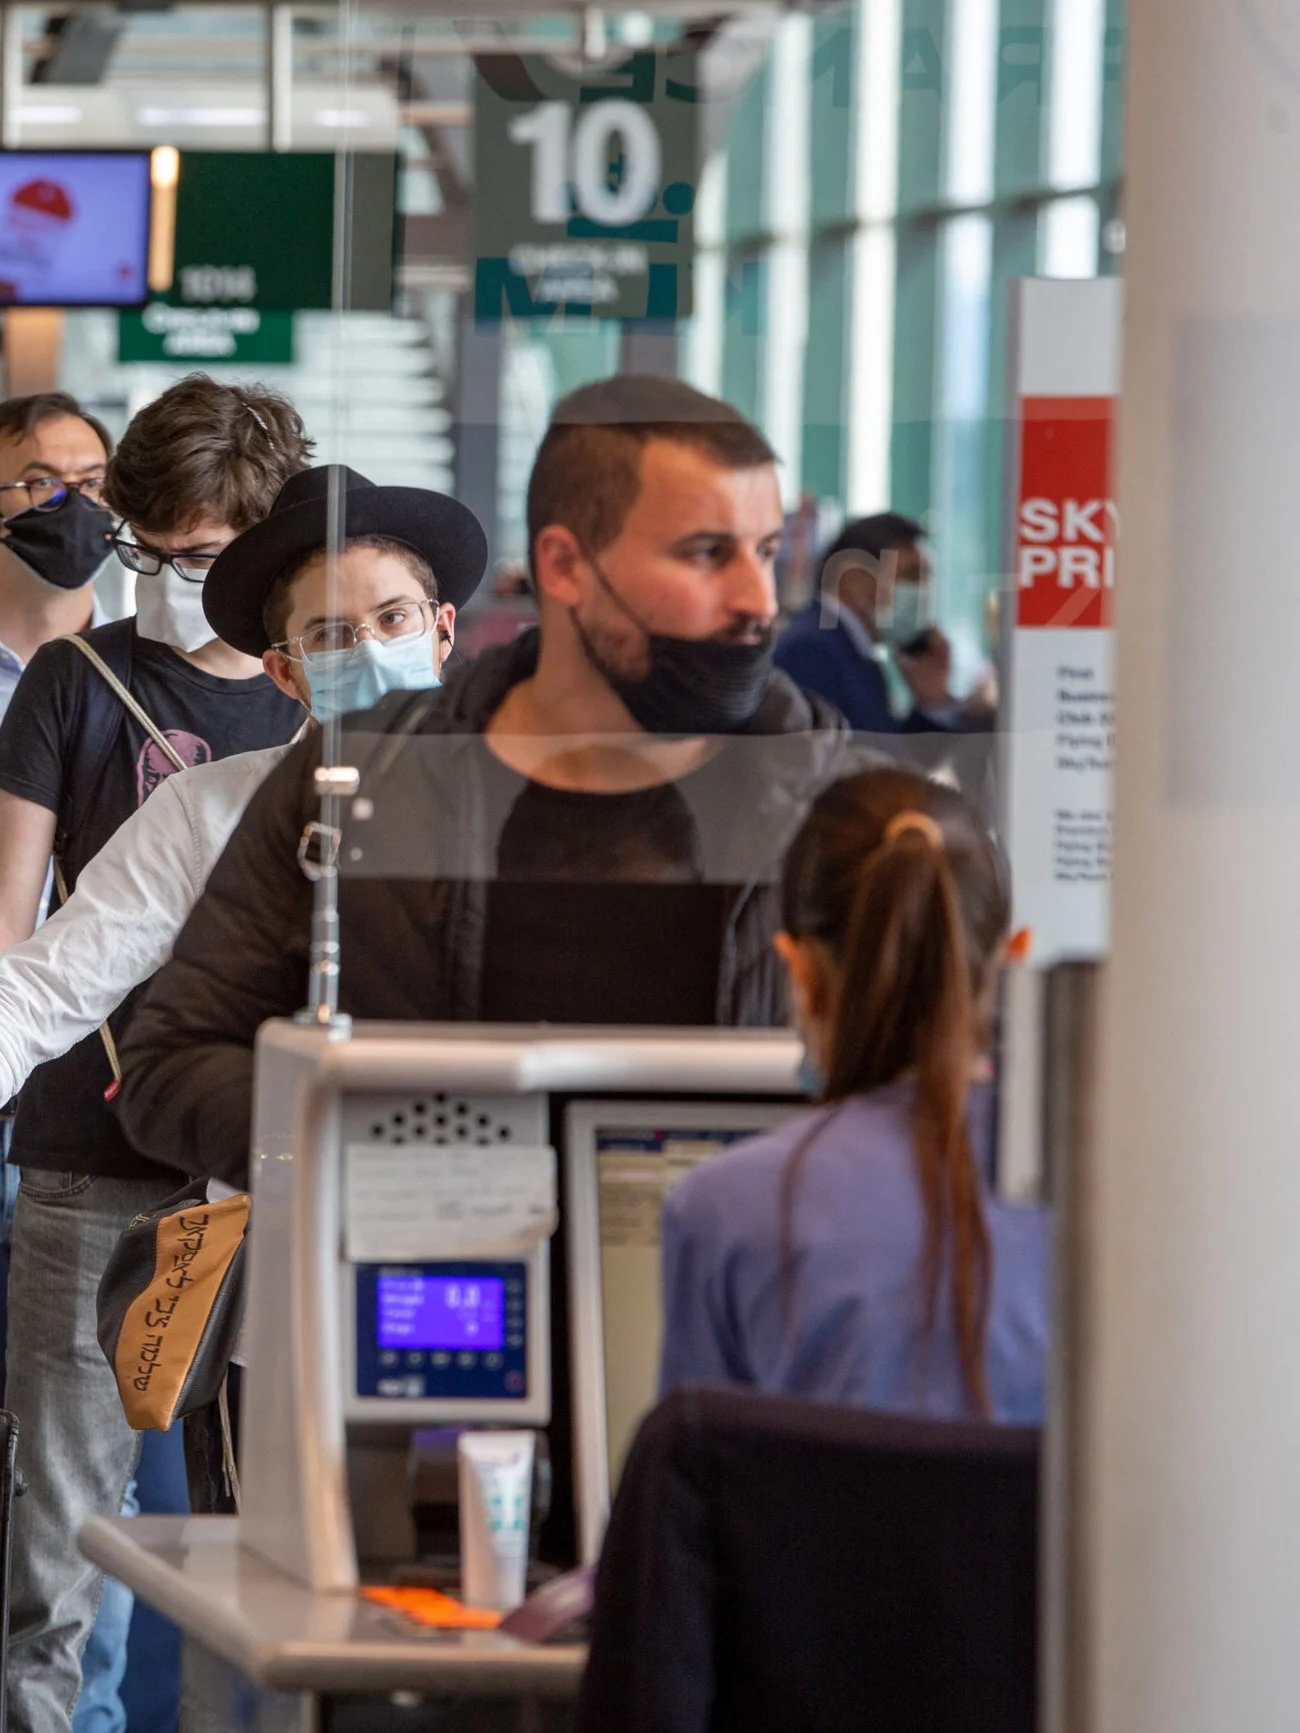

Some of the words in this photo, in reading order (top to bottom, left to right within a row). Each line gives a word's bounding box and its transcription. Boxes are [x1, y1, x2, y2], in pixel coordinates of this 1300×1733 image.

[508, 98, 663, 227] 10
[144, 1295, 179, 1329] צבי
[133, 1334, 163, 1392] שלמה
